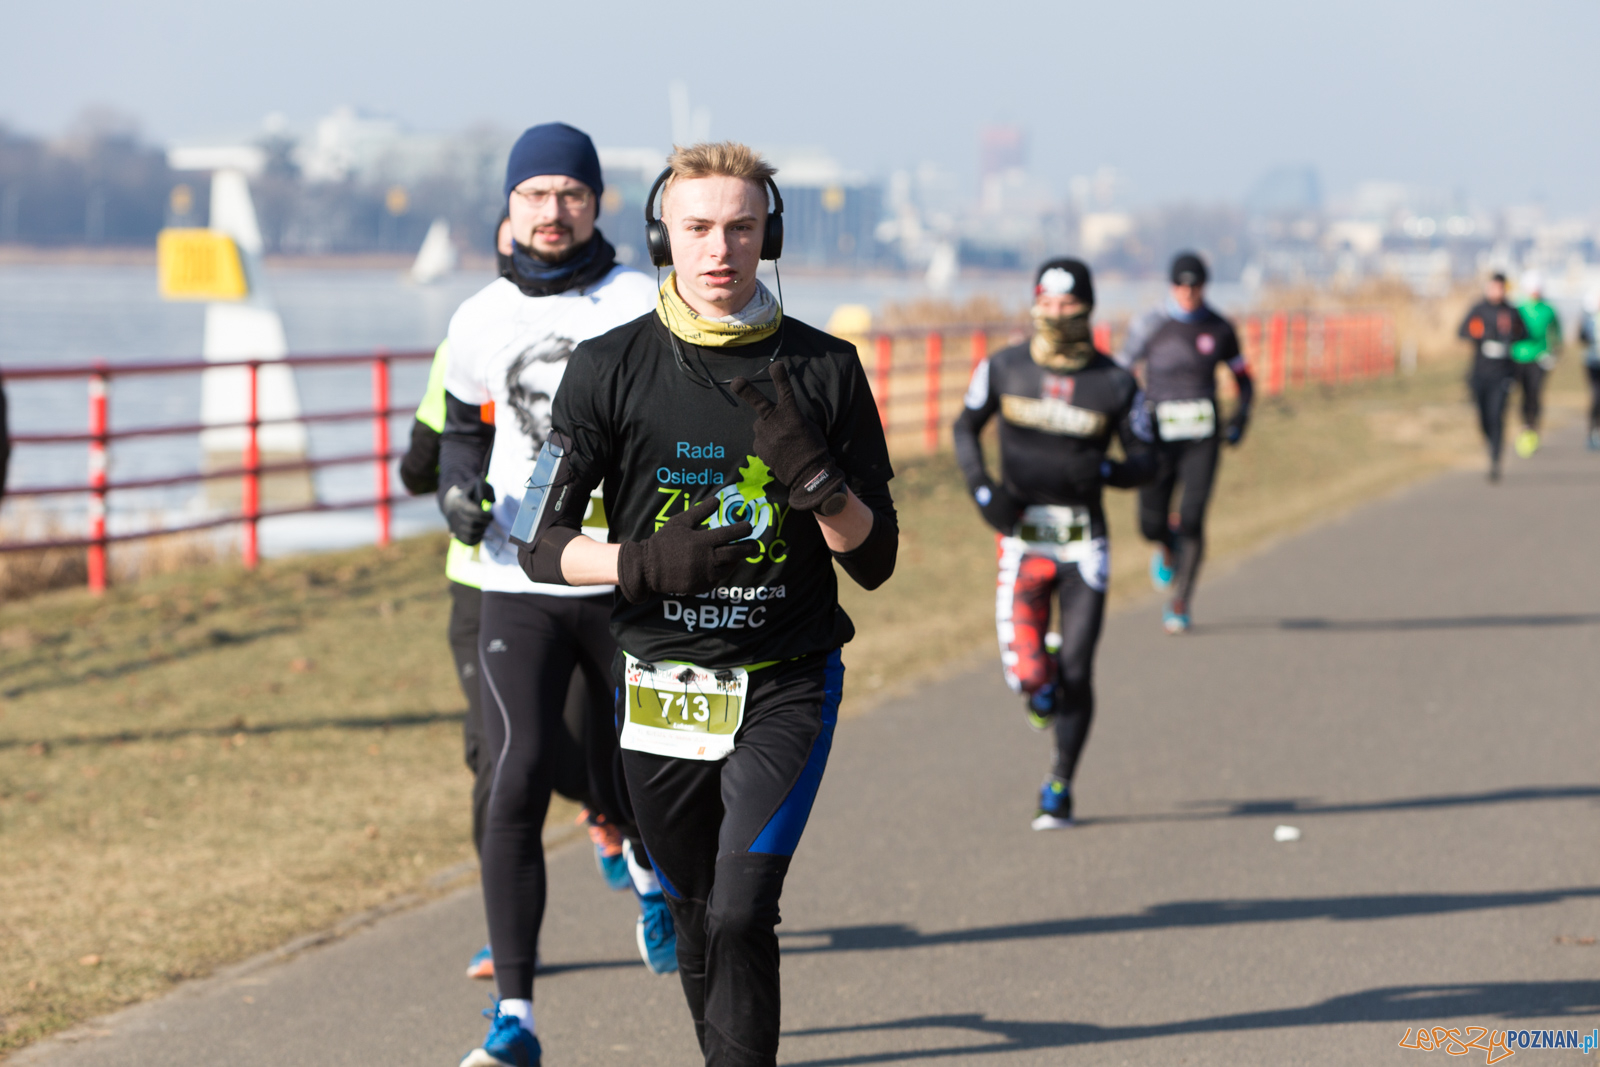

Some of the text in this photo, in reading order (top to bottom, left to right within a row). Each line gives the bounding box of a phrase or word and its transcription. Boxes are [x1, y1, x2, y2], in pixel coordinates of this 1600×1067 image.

[676, 441, 725, 459] Rada
[656, 466, 724, 485] Osiedla
[696, 584, 786, 604] iegacza
[658, 691, 710, 722] 713
